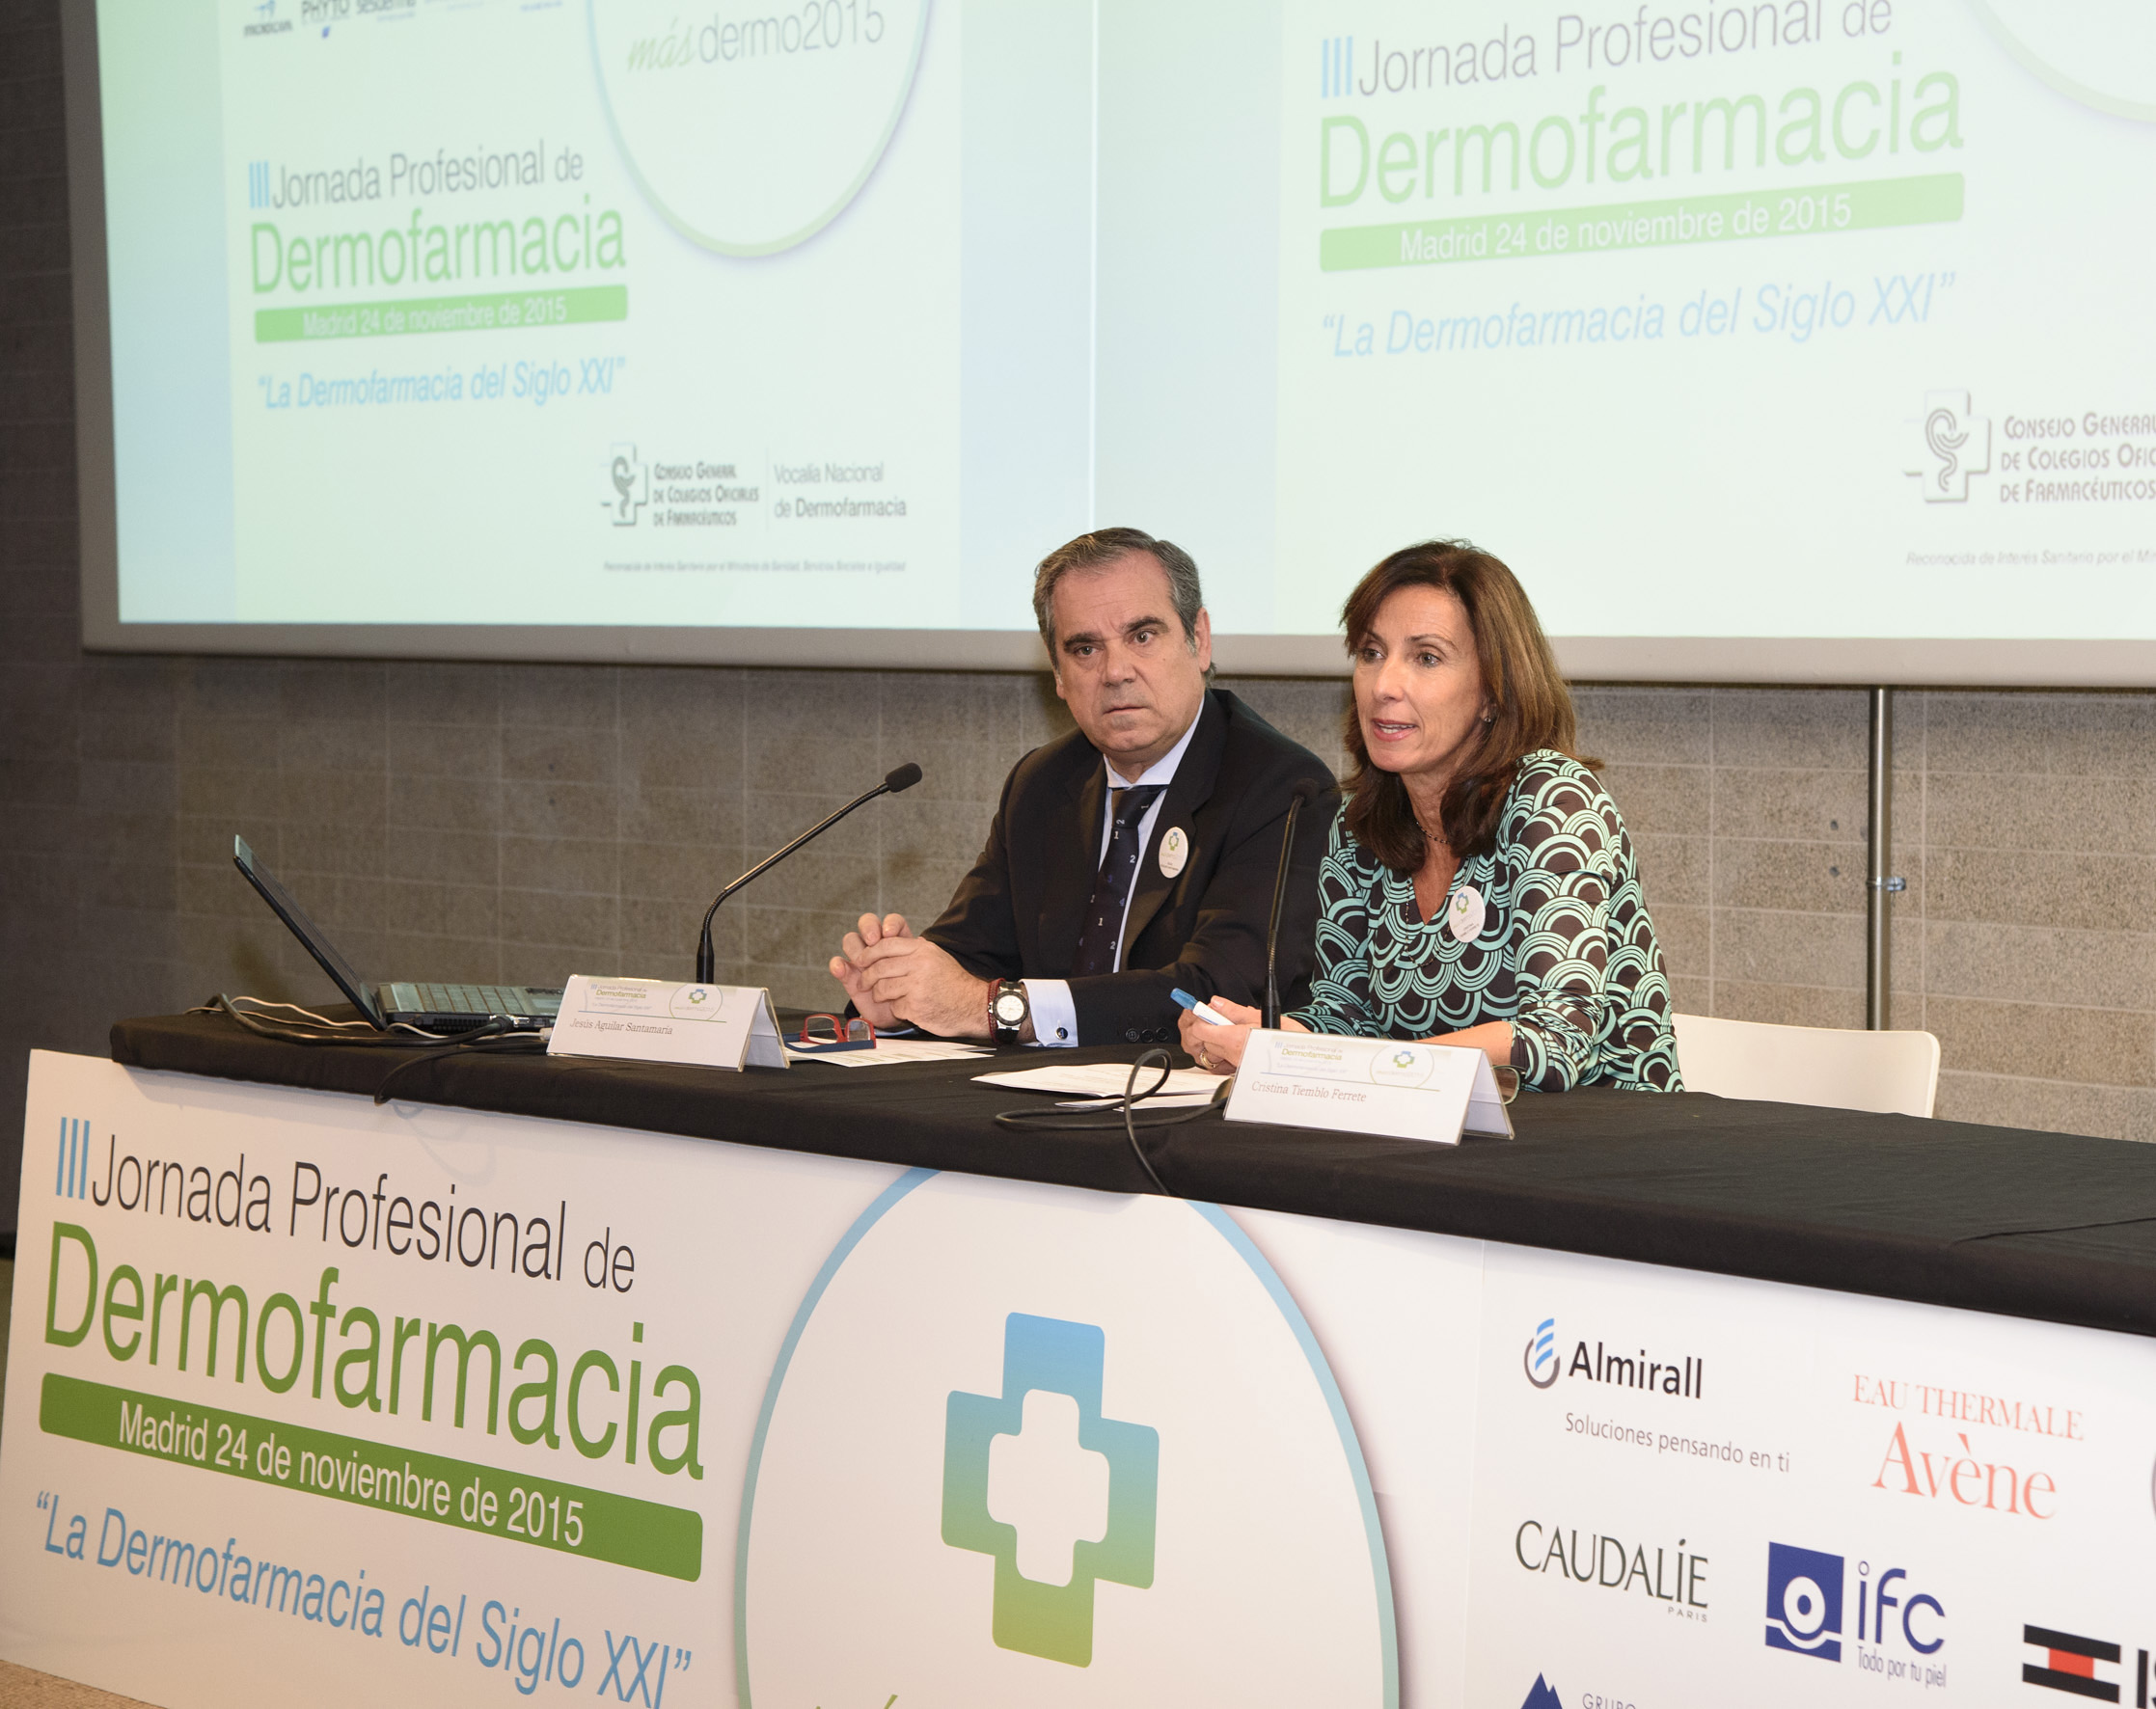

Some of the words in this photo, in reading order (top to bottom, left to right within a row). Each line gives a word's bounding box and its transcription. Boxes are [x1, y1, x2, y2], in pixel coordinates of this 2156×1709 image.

[1323, 36, 1351, 99] III
[1359, 23, 1537, 97] Jornada
[1555, 0, 1821, 73] Profesional
[1842, 0, 1893, 42] de
[1319, 50, 1964, 208] Dermofarmacia
[249, 160, 270, 209] III
[272, 156, 382, 210] Jornada
[390, 138, 545, 198] Profesional
[554, 147, 584, 182] de
[251, 192, 627, 294] Dermofarmacia
[1399, 221, 1487, 263] Madrid
[1495, 219, 1526, 255] 24
[1536, 214, 1567, 251] de
[1576, 203, 1724, 248] noviembre
[1733, 199, 1768, 236] de
[1778, 193, 1851, 233] 2015
[302, 307, 358, 338] Madrid
[360, 305, 381, 334] 24
[386, 304, 404, 332] de
[408, 301, 494, 331] noviembre
[498, 298, 520, 326] de
[526, 295, 567, 325] 2015
[1385, 293, 1664, 354] Dermofarmacia
[1678, 286, 1741, 339] del
[1753, 282, 1854, 344] Siglo
[298, 365, 463, 408] Dermofarmacia
[470, 363, 506, 400] del
[512, 359, 570, 407] Siglo
[825, 461, 883, 483] Nacional
[775, 500, 791, 519] de
[795, 495, 908, 519] Dermofarmacia
[1130, 854, 1136, 863] 2
[1109, 940, 1116, 950] 2
[594, 1020, 624, 1032] Aguilar
[1251, 1081, 1289, 1095] Cristina
[1292, 1084, 1329, 1099] Tiemblo
[1331, 1088, 1367, 1102] Ferrete
[56, 1116, 91, 1201] III
[93, 1133, 271, 1234] Jornada
[289, 1160, 566, 1282] Profesional
[584, 1226, 635, 1293] de
[44, 1220, 704, 1481] Dermofarmacia
[1568, 1341, 1704, 1399] Almirall
[1852, 1373, 1910, 1411] EAU
[1915, 1383, 2085, 1442] THERMALE
[119, 1399, 207, 1462] Madrid
[214, 1424, 248, 1471] 24
[257, 1432, 290, 1481] de
[298, 1449, 451, 1516] noviembre
[459, 1477, 498, 1527] de
[507, 1486, 585, 1548] 2015
[1566, 1412, 1653, 1447] Soluciones
[1658, 1432, 1744, 1464] pensando
[1749, 1451, 1772, 1470] en
[1777, 1451, 1790, 1473] ti
[1869, 1420, 2057, 1520] Avène
[38, 1490, 88, 1561] “La
[97, 1506, 386, 1639] Dermofarmacia
[398, 1585, 466, 1658] del
[476, 1600, 585, 1695] Siglo
[1515, 1520, 1709, 1610] CAUDALÍE
[1667, 1605, 1709, 1623] PARIS
[1858, 1560, 1946, 1655] ifc
[1858, 1644, 1885, 1674] Todo
[1887, 1659, 1906, 1681] por
[1910, 1660, 1922, 1681] tu
[1925, 1663, 1947, 1690] piel
